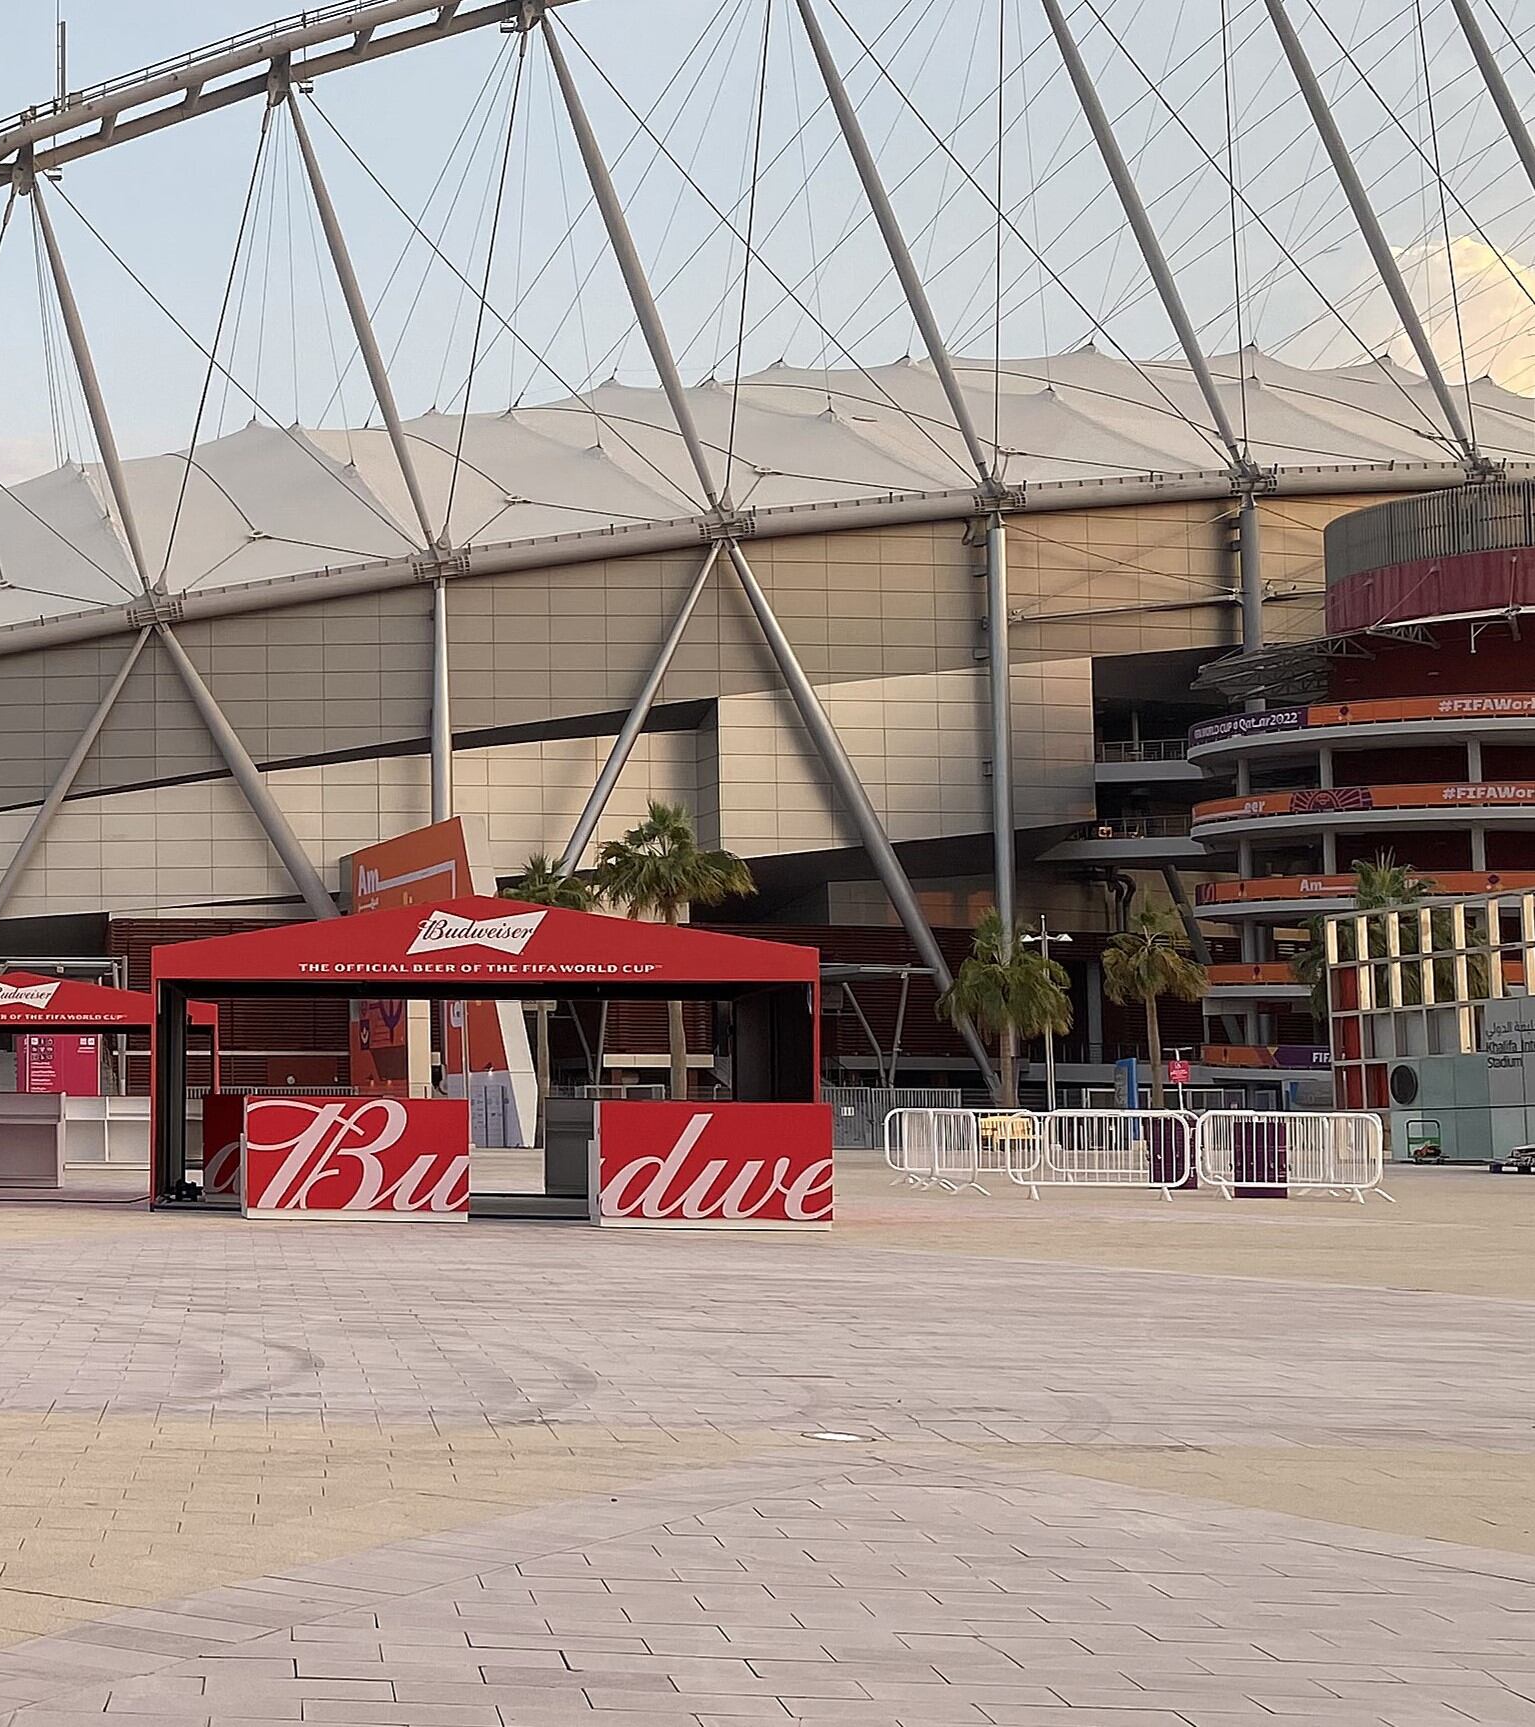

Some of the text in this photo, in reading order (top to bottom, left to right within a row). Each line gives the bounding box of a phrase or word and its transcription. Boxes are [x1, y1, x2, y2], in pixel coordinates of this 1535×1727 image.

[418, 920, 535, 941] Budweiser
[298, 963, 330, 973] THE
[334, 963, 409, 973] OFFICIAL
[413, 963, 456, 973] BEER
[460, 963, 482, 973] OF
[486, 963, 518, 973] THE
[522, 963, 557, 973] FIFA
[559, 963, 618, 973] WORLD
[247, 1099, 470, 1212] Bu
